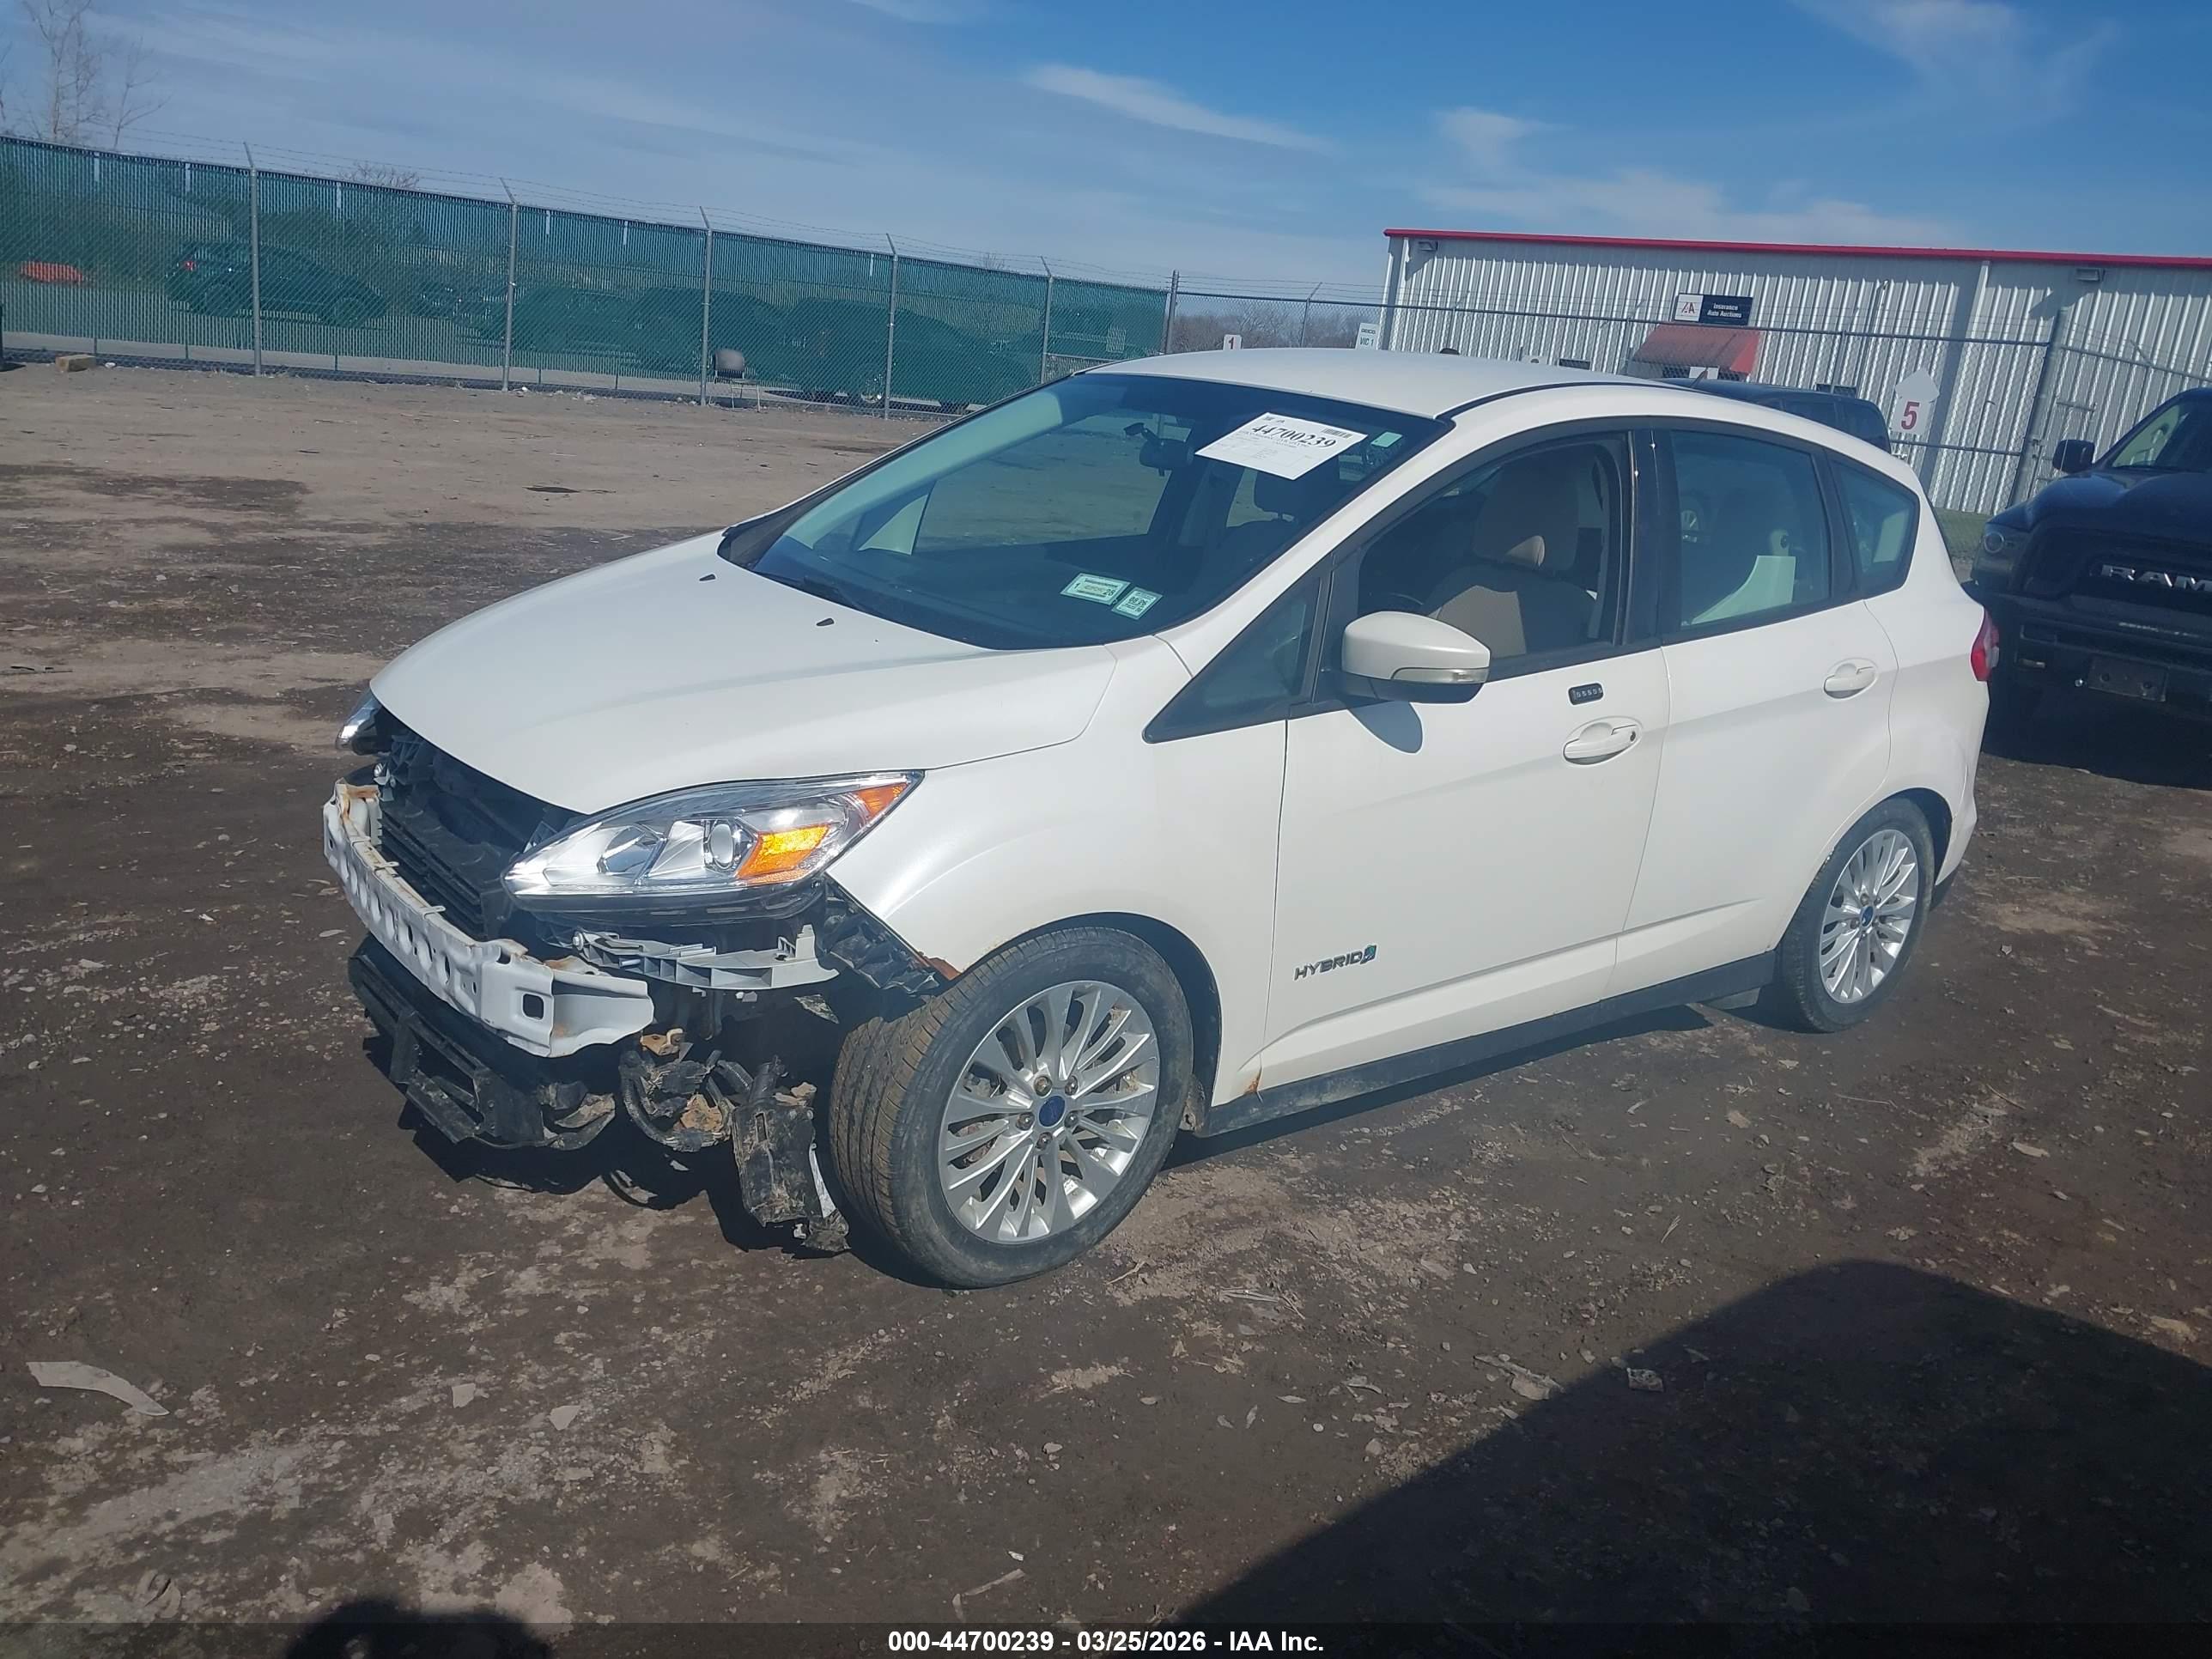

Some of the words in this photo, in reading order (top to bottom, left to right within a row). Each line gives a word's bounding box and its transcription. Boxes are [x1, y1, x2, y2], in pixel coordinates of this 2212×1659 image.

[1713, 302, 1739, 311] Insurance
[1228, 337, 1235, 349] 1
[1900, 400, 1920, 430] 5
[1251, 424, 1337, 449] 44700239
[2101, 564, 2212, 592] RAM
[1294, 950, 1363, 981] HYBRID
